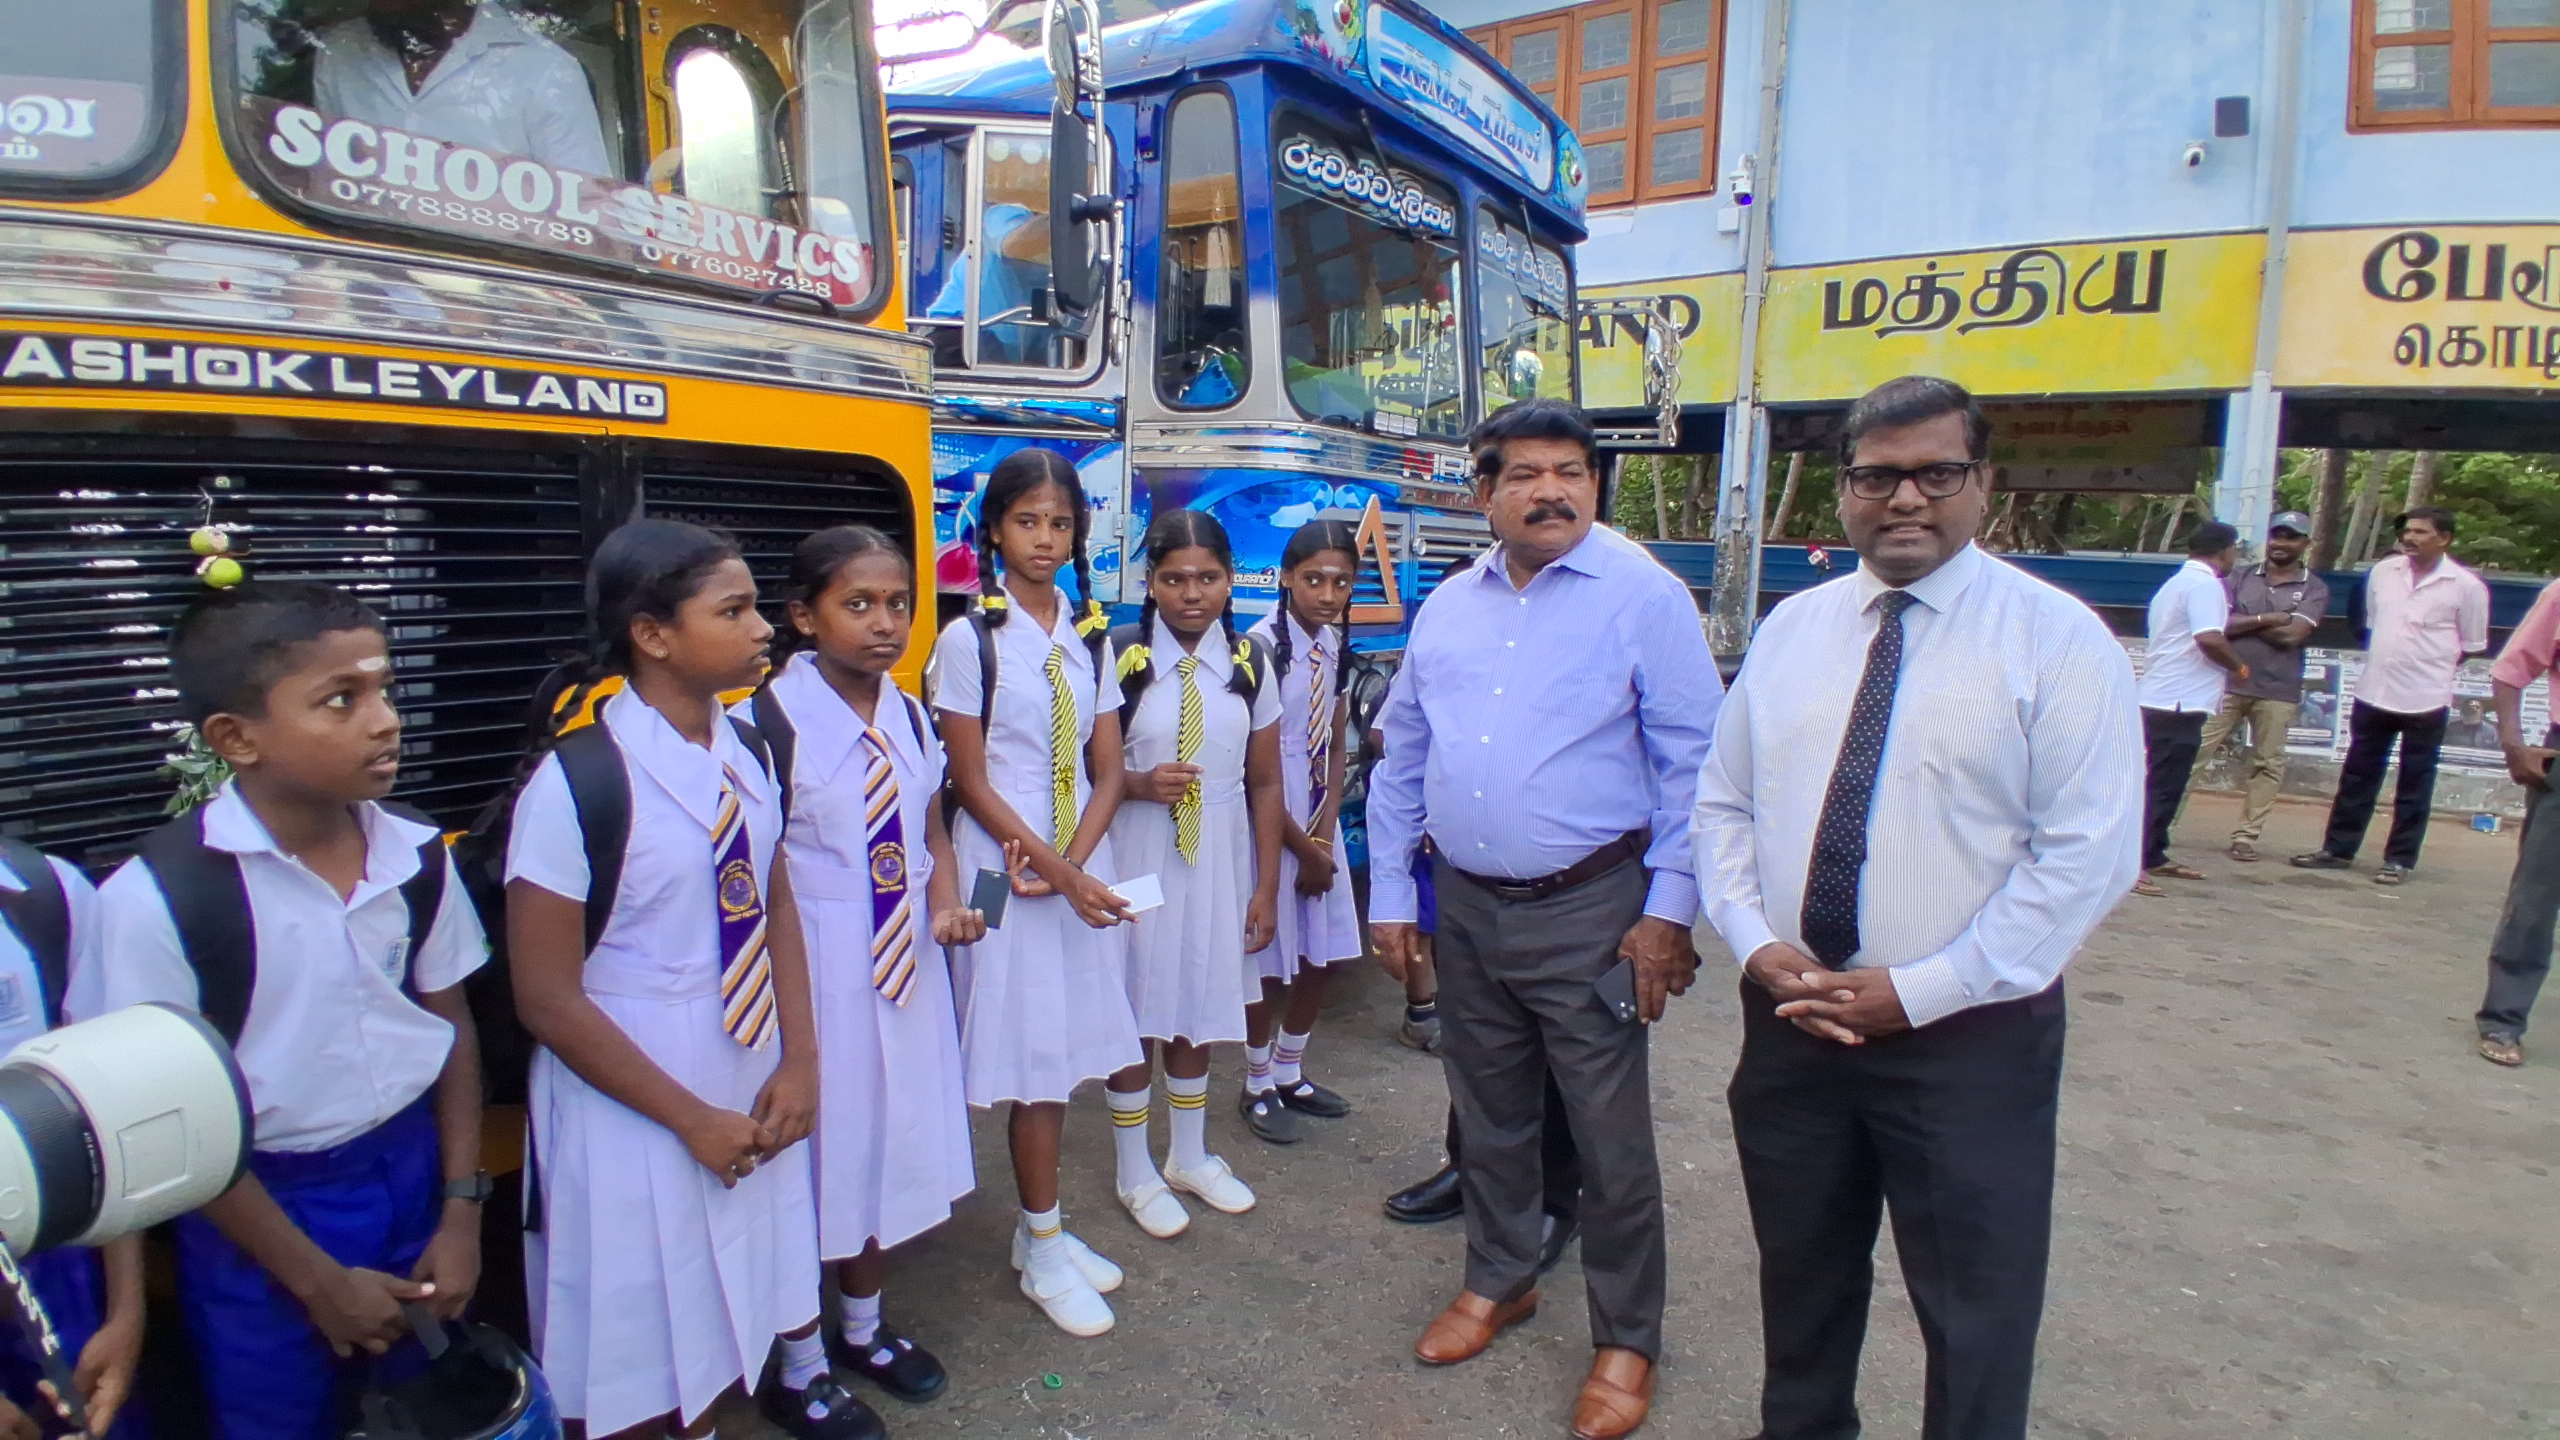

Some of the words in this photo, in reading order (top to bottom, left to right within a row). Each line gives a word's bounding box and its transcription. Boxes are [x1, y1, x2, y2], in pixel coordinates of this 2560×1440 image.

[270, 106, 598, 225] SCHOOL
[611, 186, 860, 284] SERVICS
[331, 179, 594, 245] 0778888789
[641, 243, 832, 299] 0776027428
[1822, 249, 2168, 339] மத்திய
[3, 336, 314, 392] ASHOK
[331, 356, 666, 418] LEYLAND
